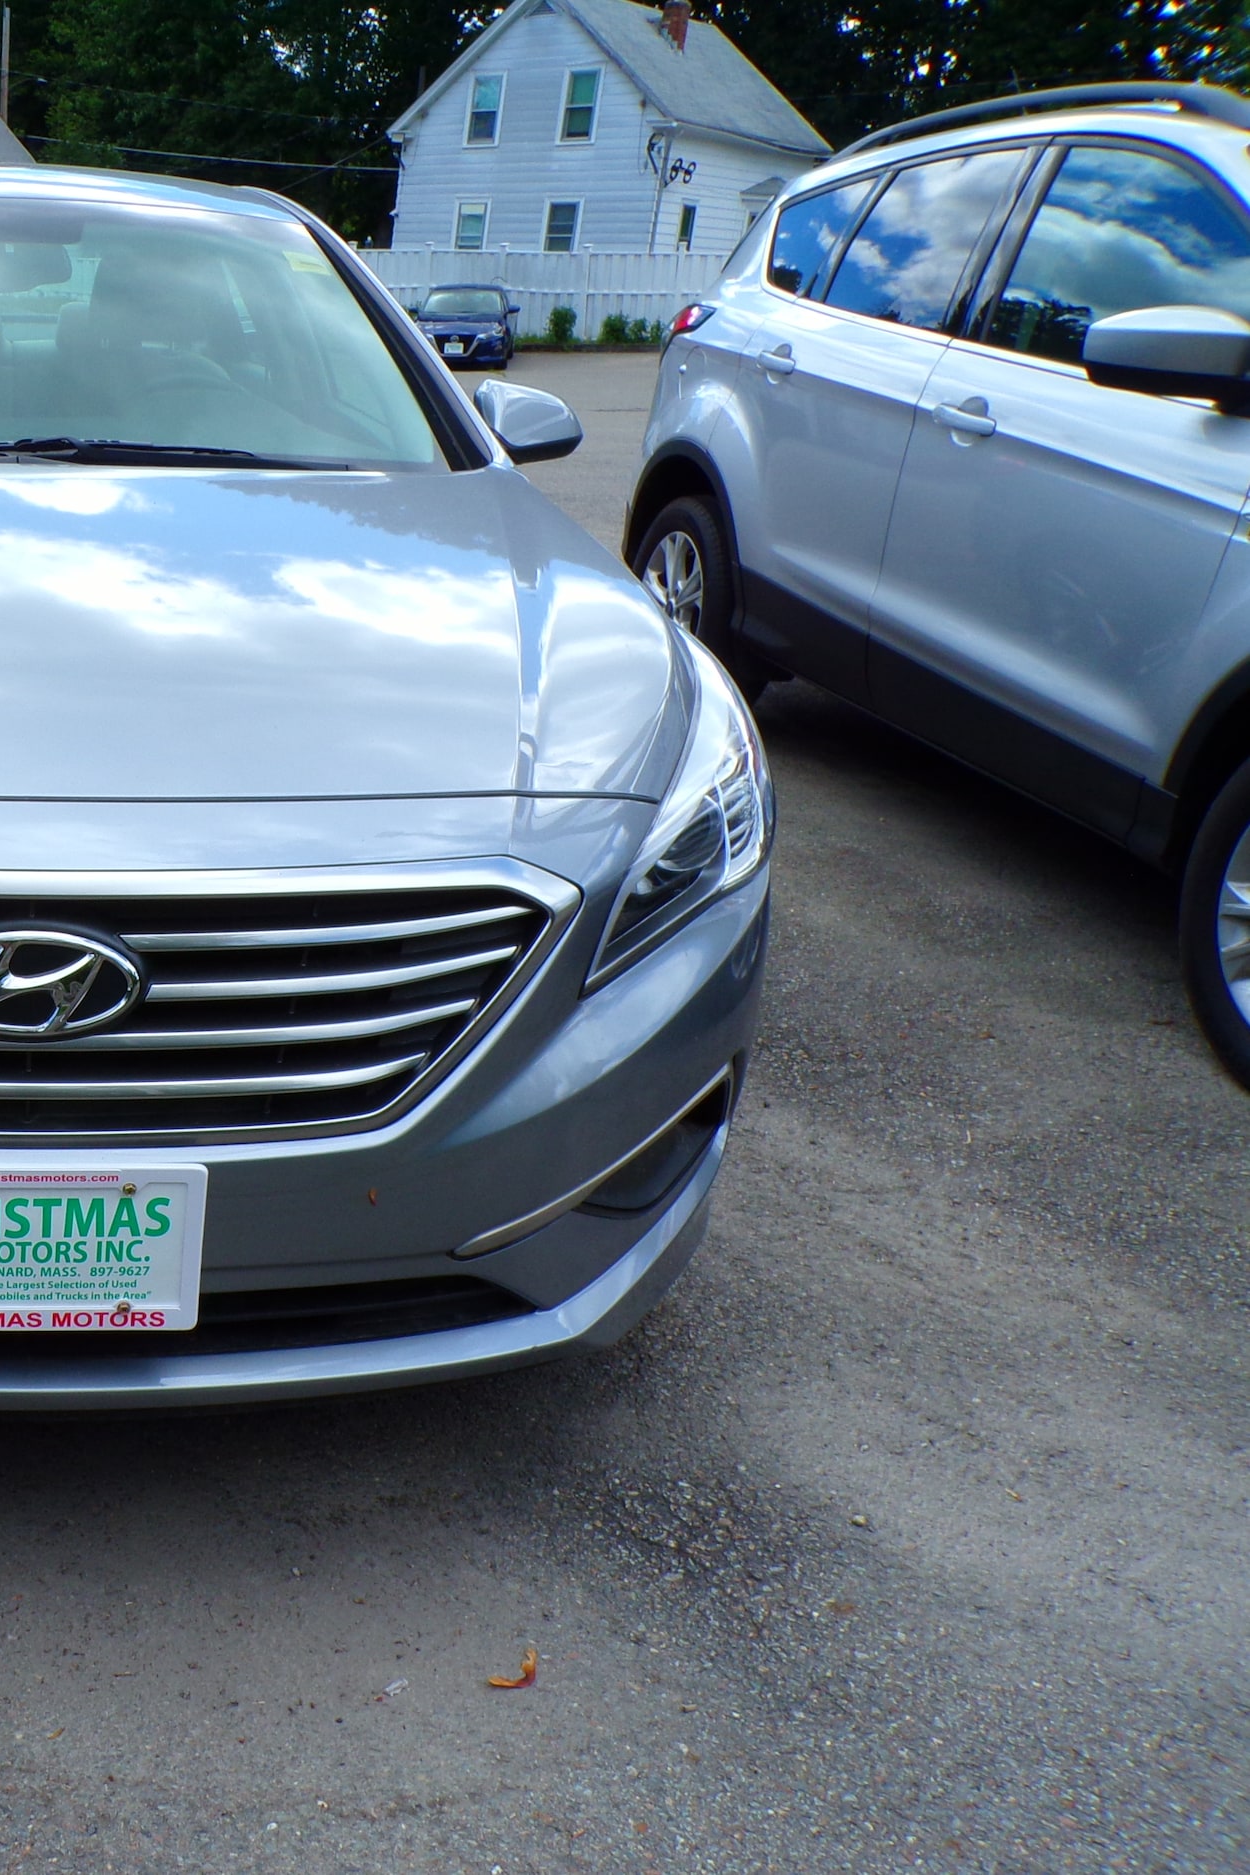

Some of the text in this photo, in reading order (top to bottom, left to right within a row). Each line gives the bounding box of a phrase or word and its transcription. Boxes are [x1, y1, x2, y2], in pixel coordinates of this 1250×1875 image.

[95, 1239, 150, 1263] INC.
[40, 1266, 81, 1278] MASS.
[90, 1265, 150, 1277] 897-9627
[6, 1280, 45, 1292] Largest
[47, 1280, 96, 1289] Selection
[98, 1279, 110, 1289] of
[111, 1279, 137, 1289] Used
[33, 1291, 53, 1301] and
[55, 1291, 89, 1301] Trucks
[90, 1291, 101, 1301] in
[103, 1290, 120, 1300] the
[51, 1311, 165, 1328] MOTORS
